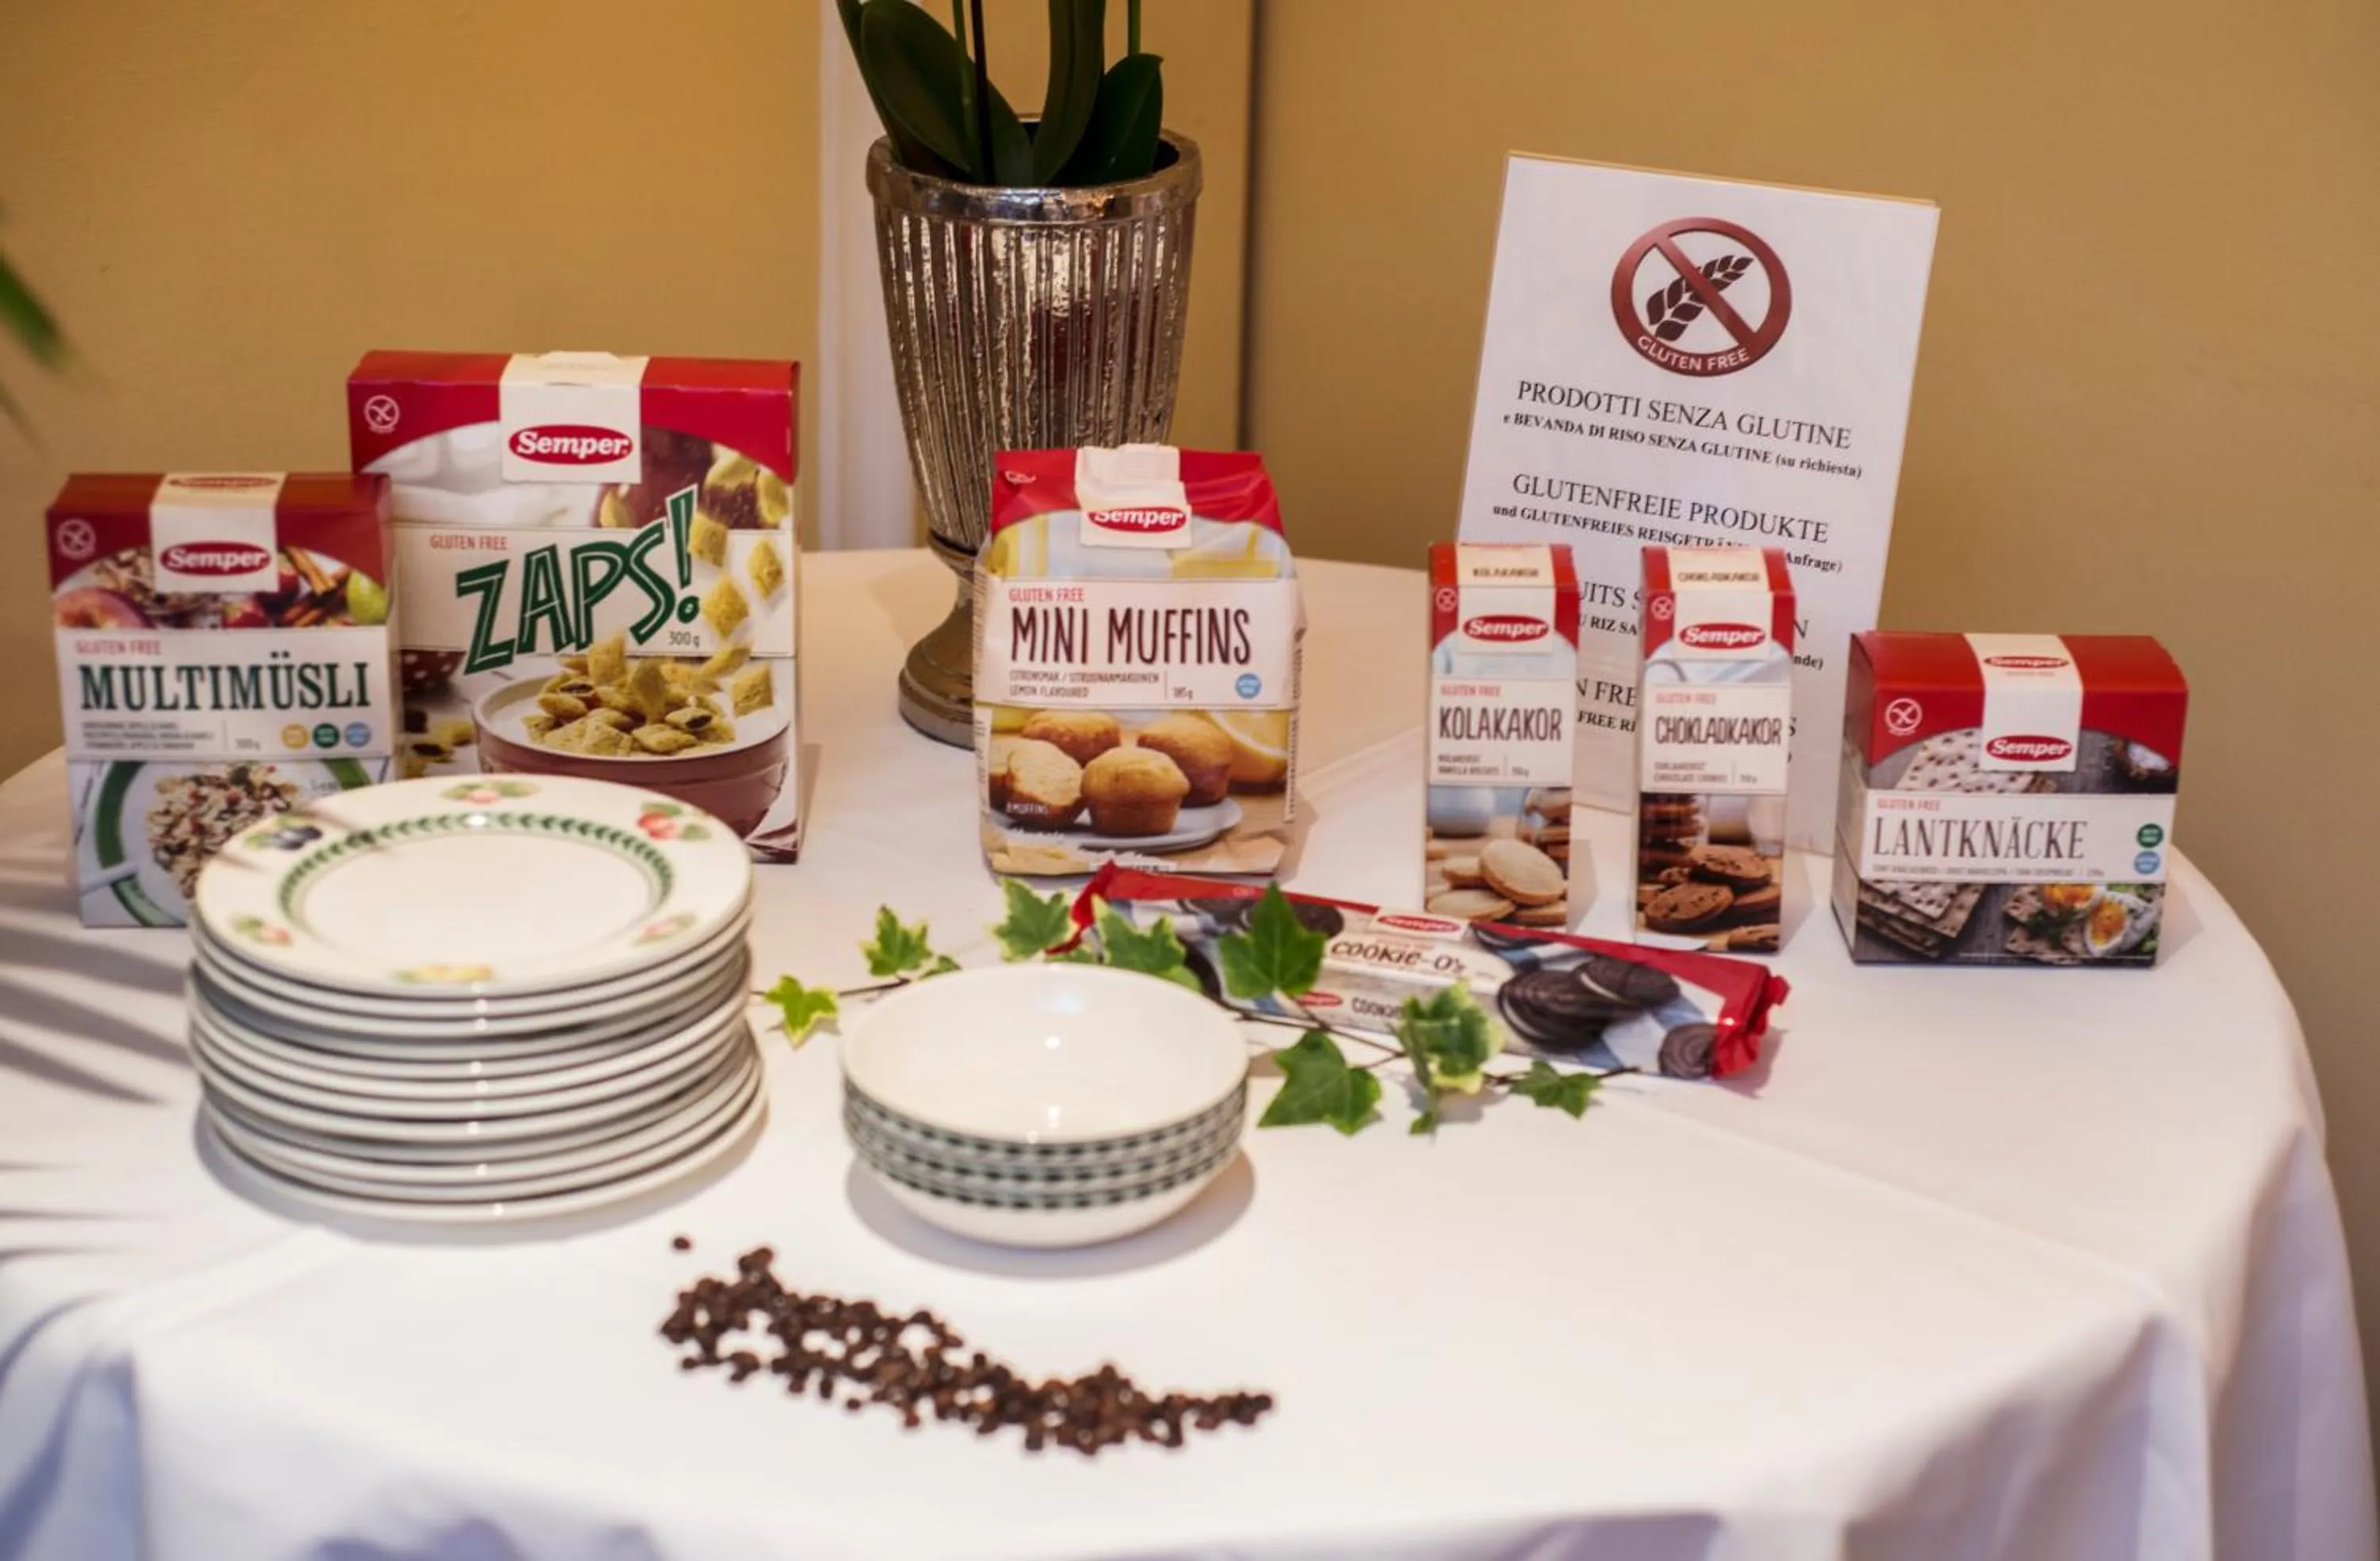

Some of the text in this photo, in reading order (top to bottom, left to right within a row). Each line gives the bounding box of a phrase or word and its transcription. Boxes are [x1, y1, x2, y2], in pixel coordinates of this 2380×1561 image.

[1637, 336, 1750, 371] GLUTEN FREE
[1517, 380, 1852, 450] PRODOTTI SENZA GLUTINE
[517, 431, 629, 459] Semper
[1503, 412, 1863, 480] e BEVANDA DI RISO SENZA GLUTINE (su richiesta)
[1095, 511, 1184, 529] Semper
[1513, 474, 1829, 543] GLUTENFREIE PRODUKTE
[1493, 505, 1518, 517] und
[1520, 507, 1635, 537] GLUTENFREIES
[431, 535, 508, 550] GLUTEN FREE
[167, 547, 267, 571] Semper
[456, 488, 701, 675] ZAPS!
[1008, 588, 1084, 603] GLUTEN FREE
[1011, 606, 1088, 664] MINI
[1107, 607, 1251, 665] MUFFINS
[1468, 619, 1546, 639] Semper
[1590, 616, 1616, 632] RIZ
[76, 640, 162, 656] GLUTEN FREE
[1684, 627, 1763, 646] Semper
[78, 650, 370, 711] MULTIMÜSLI
[1441, 685, 1501, 697] GLUTEN FREE
[1656, 692, 1717, 705] GLUTEN FREE
[1439, 706, 1562, 742] KOLAKAKOR
[1577, 710, 1616, 729] FREE
[1656, 715, 1783, 745] CHOKLADKAKOR
[1990, 738, 2071, 759] Semper
[1877, 798, 1940, 811] GLUTEN FREE
[1873, 816, 2088, 859] LANTKNÄCKE
